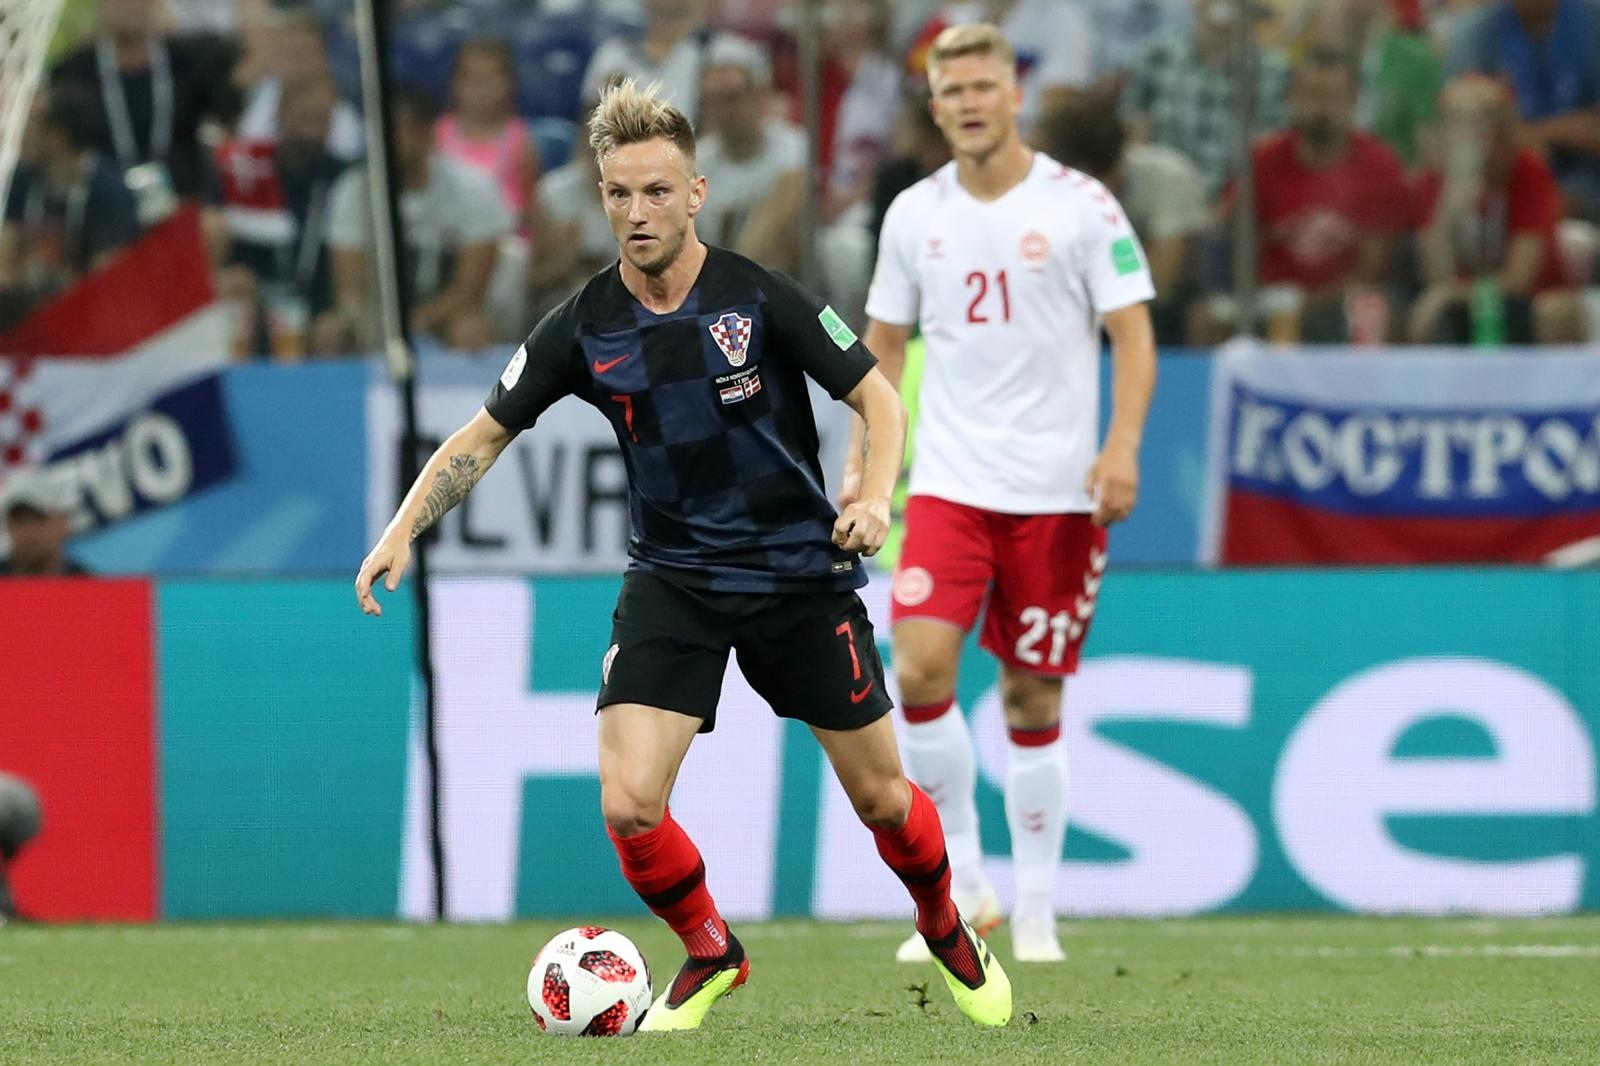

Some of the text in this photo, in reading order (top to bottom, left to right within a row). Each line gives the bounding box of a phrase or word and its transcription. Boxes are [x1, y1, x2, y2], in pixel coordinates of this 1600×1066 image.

[965, 269, 1010, 323] 21
[611, 393, 638, 443] 7
[835, 620, 862, 681] 7
[1014, 605, 1071, 667] 21
